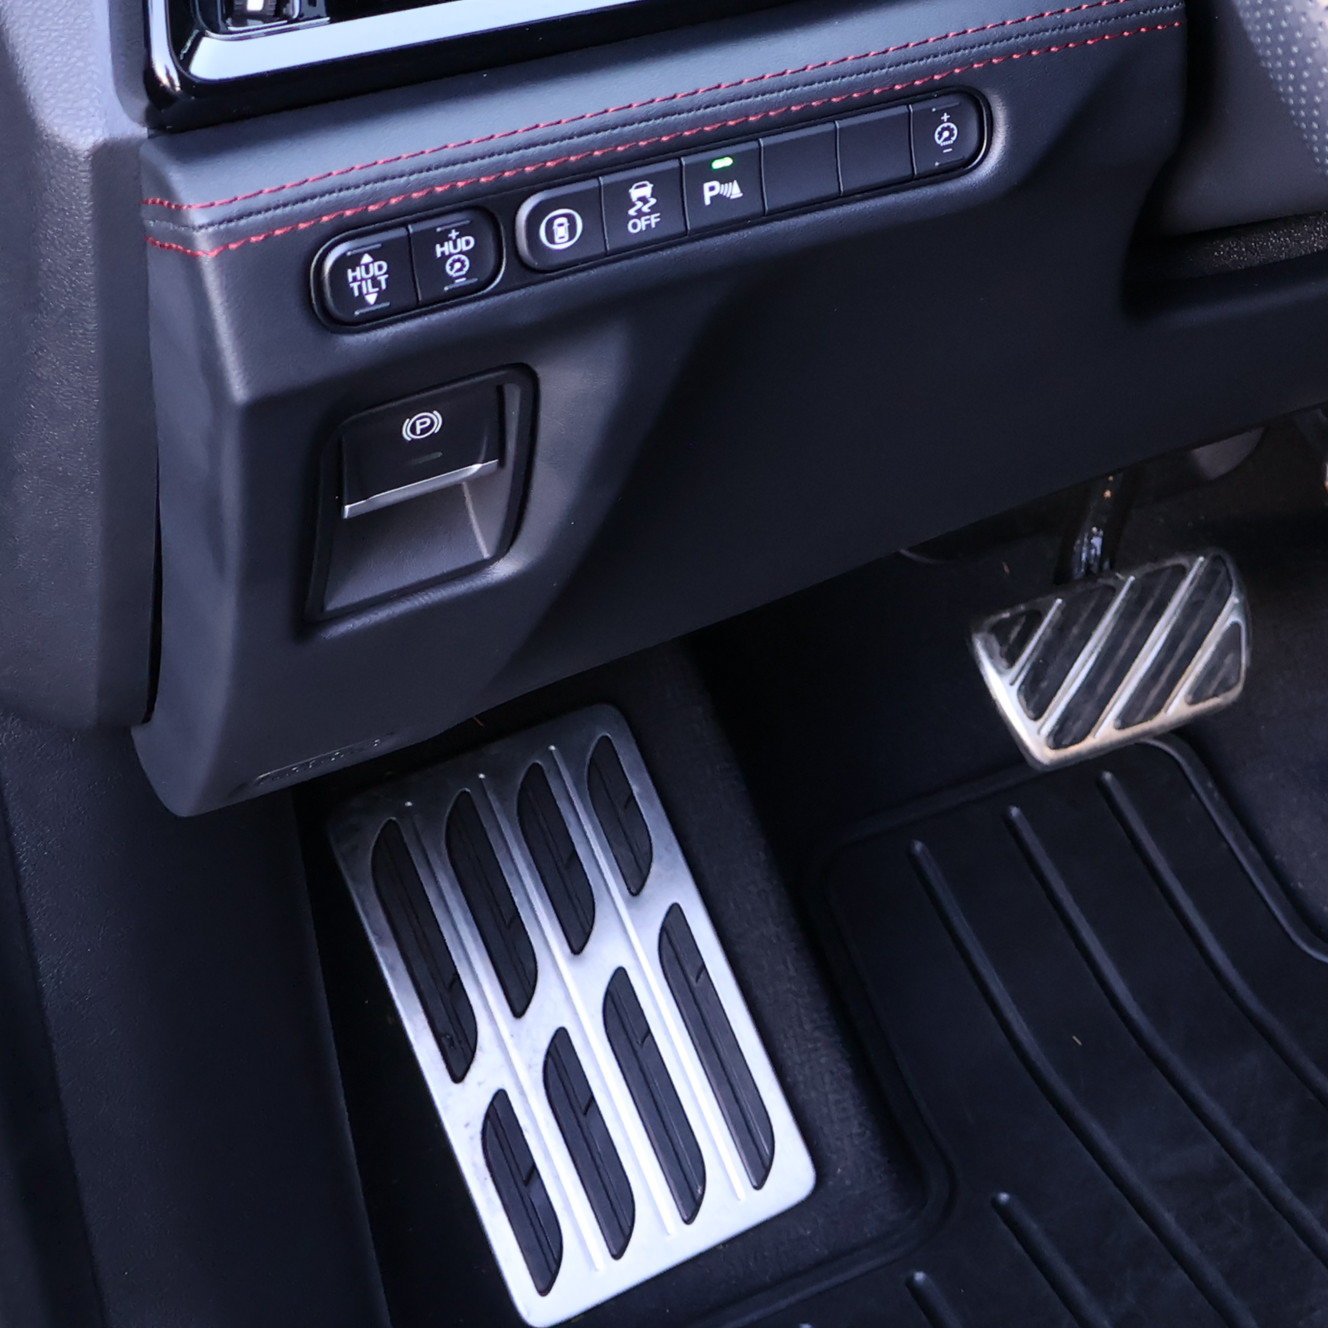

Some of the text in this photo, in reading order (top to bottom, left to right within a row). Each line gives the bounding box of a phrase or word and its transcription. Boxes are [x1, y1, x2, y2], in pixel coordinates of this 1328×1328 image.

[627, 213, 661, 233] OFF
[435, 236, 475, 258] HUD
[347, 261, 388, 282] HUD
[350, 274, 389, 297] TILT
